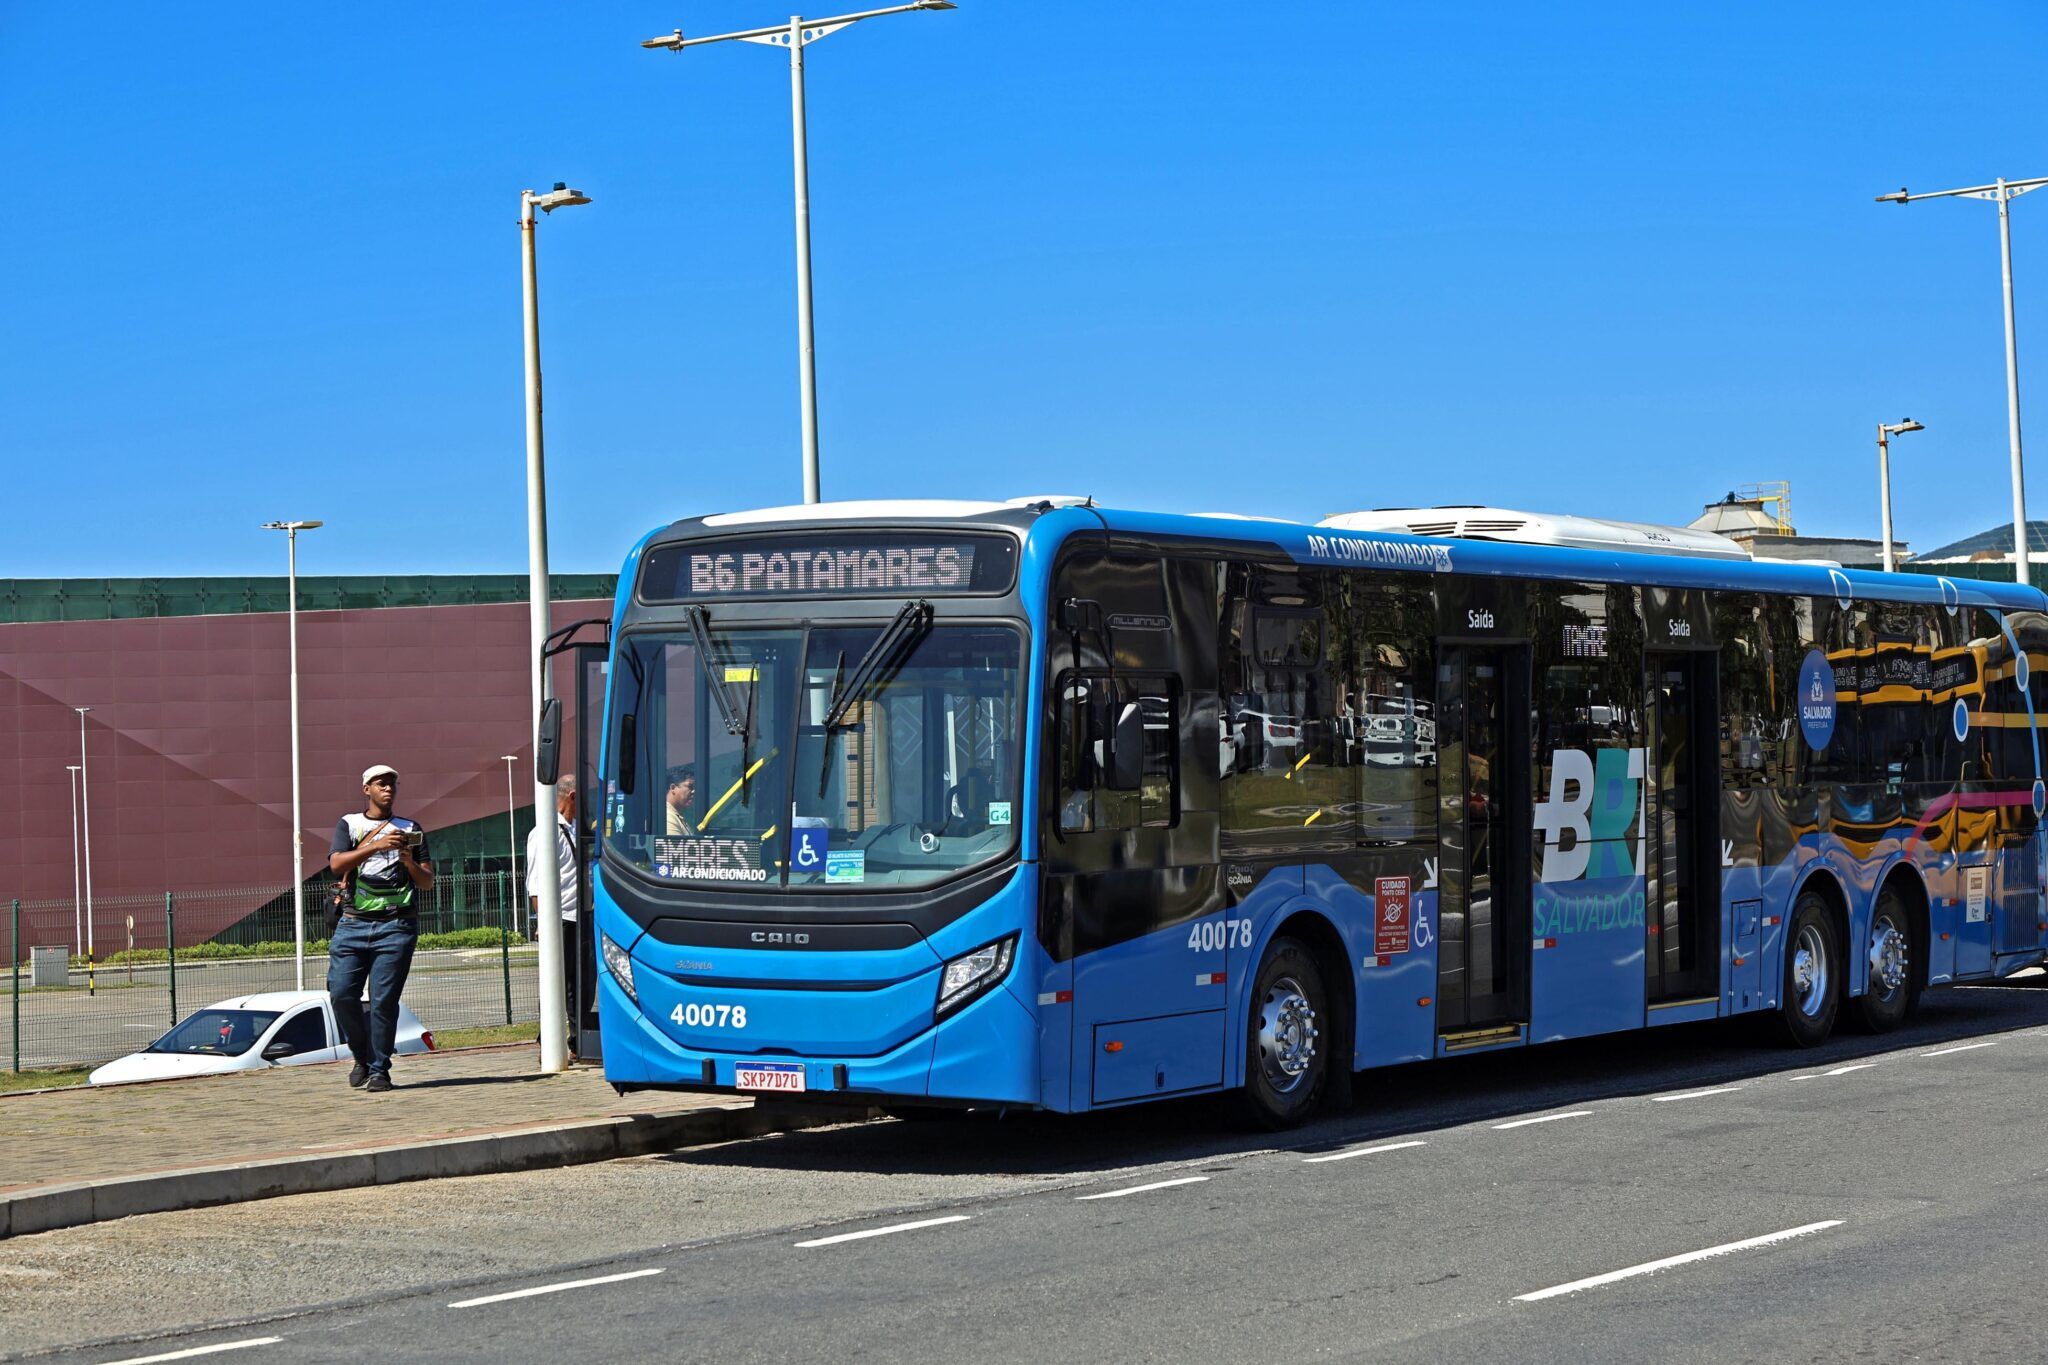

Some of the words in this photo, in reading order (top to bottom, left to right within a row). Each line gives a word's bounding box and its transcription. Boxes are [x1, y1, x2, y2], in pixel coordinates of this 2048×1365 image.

[1307, 535, 1330, 557] AR
[1330, 537, 1436, 565] CONDICIONADO
[691, 554, 735, 591] B6
[743, 547, 960, 590] PATAMARES
[1468, 608, 1494, 628] Saída
[1669, 619, 1690, 636] Saída
[1803, 706, 1832, 719] SALVADOR
[990, 810, 1009, 821] G4
[671, 866, 687, 878] AR
[688, 866, 767, 881] CONDICIONADO
[1227, 875, 1252, 885] SCANIA
[1381, 880, 1406, 890] CUIDADO
[1533, 892, 1645, 936] SALVADOR
[751, 932, 810, 944] CAIO
[1187, 918, 1252, 952] 40078
[670, 1003, 747, 1028] 40078
[742, 1071, 798, 1088] SKP7D70
